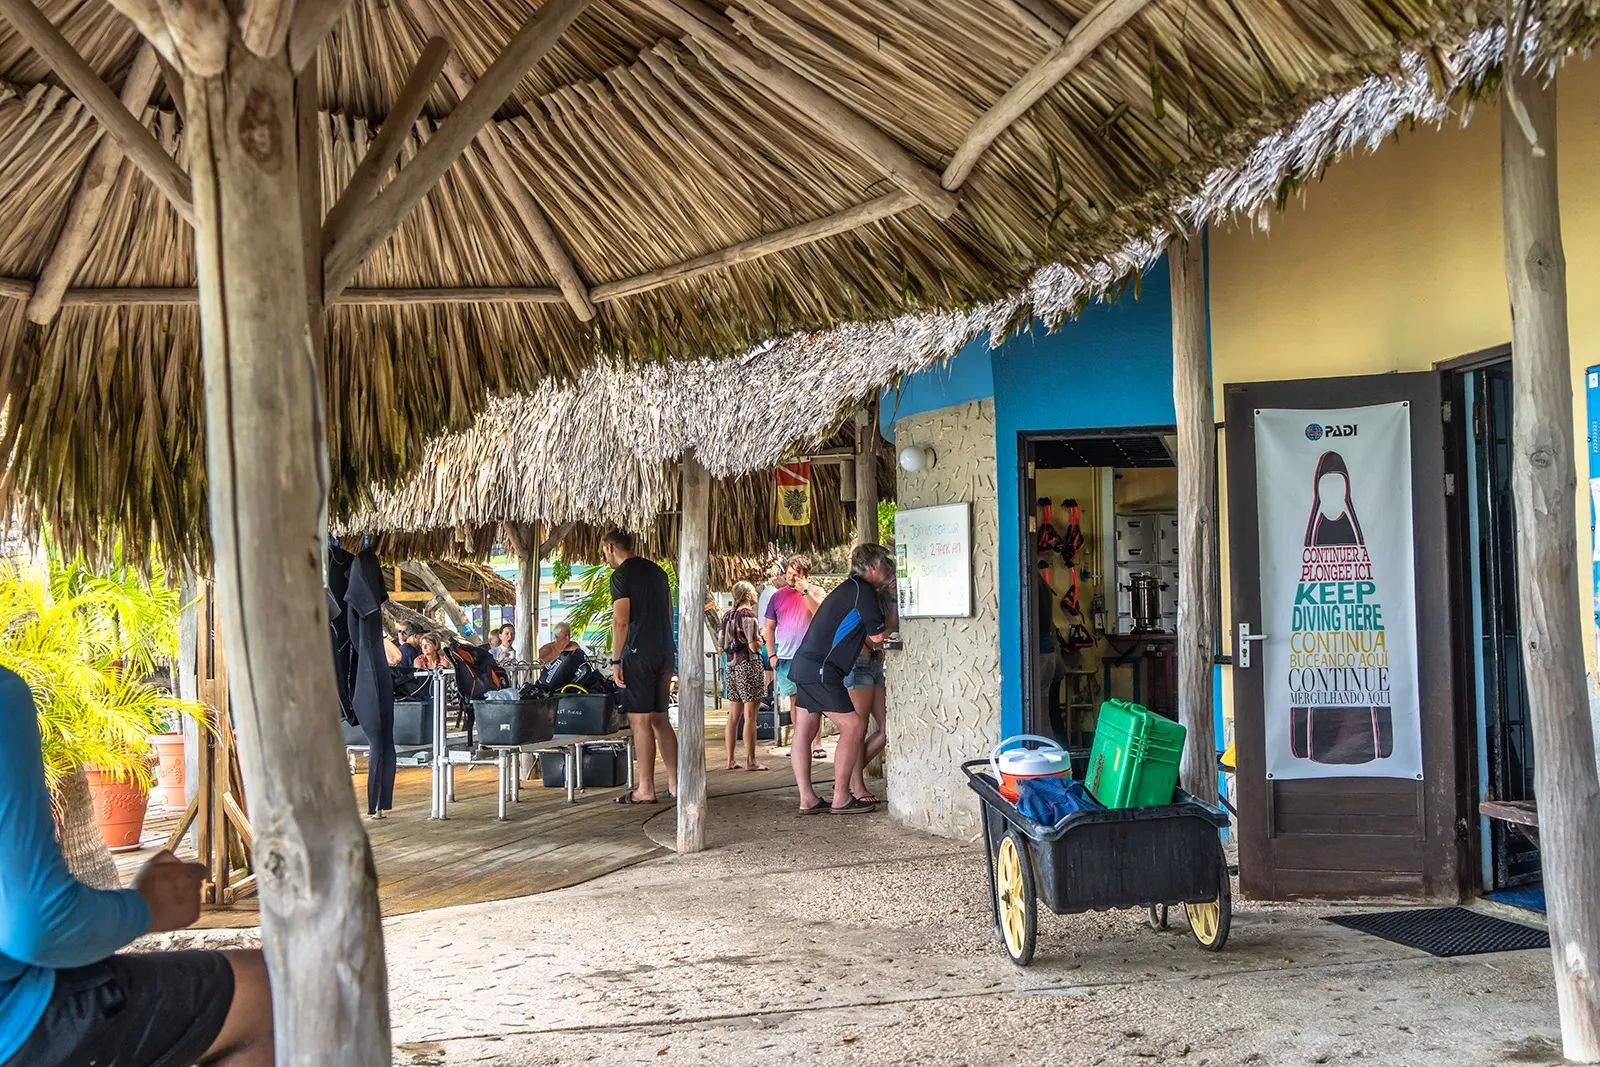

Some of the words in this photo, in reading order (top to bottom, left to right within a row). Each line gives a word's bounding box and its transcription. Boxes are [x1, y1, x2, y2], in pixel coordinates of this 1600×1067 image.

[1325, 424, 1358, 437] PADI
[929, 543, 936, 556] 2
[1302, 546, 1360, 563] CONTINUER
[1299, 563, 1353, 582] PLONGEE
[1354, 562, 1374, 581] ICI
[1294, 581, 1376, 605] KEEP
[1291, 605, 1341, 632] DIVING
[1344, 604, 1385, 631] HERE
[1289, 653, 1356, 669] BUCEANDO
[1288, 667, 1390, 693] CONTINUE
[1289, 691, 1365, 705] MERGULHANDO
